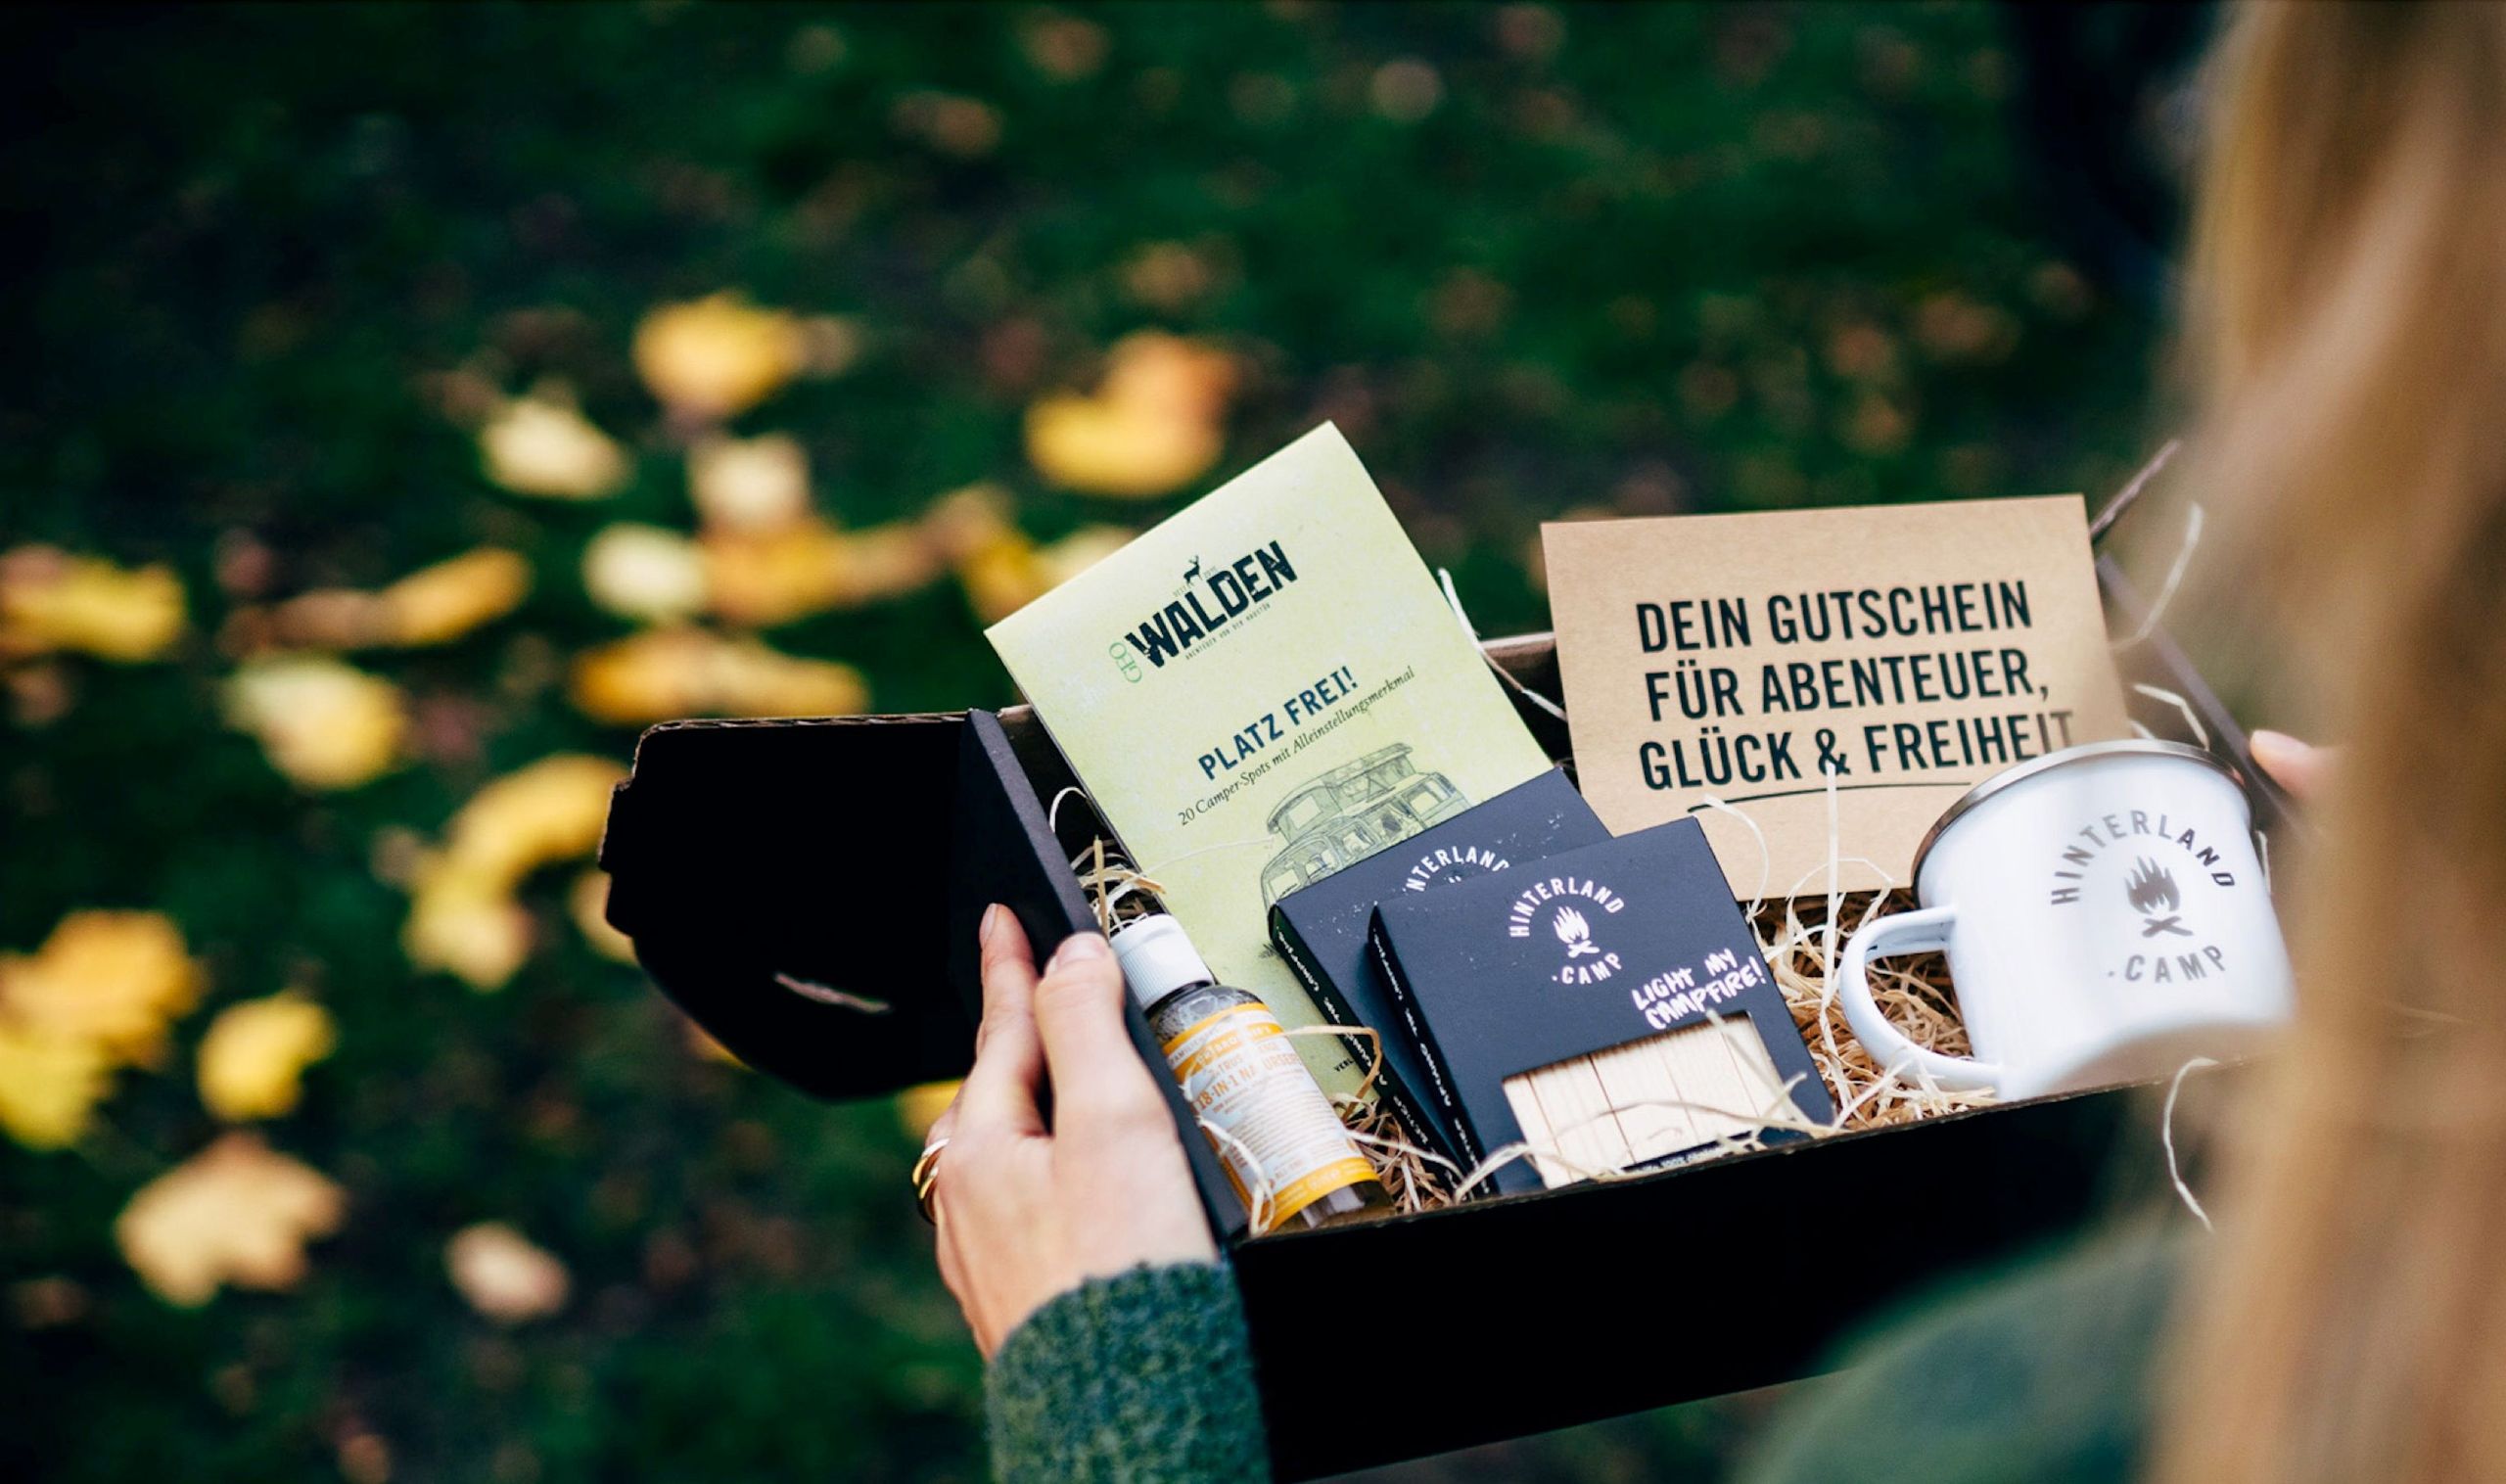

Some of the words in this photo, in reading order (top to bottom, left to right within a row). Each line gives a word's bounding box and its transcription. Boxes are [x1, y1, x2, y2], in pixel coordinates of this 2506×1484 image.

[1124, 540, 1298, 669] WALDEN
[1636, 597, 1751, 654] DEIN
[1767, 580, 2032, 645] GUTSCHEIN
[1197, 713, 1284, 780] PLATZ
[1283, 665, 1359, 725] FREI!
[1645, 659, 1744, 722] FÜR
[1762, 648, 2049, 715] ABENTEUER,
[1178, 808, 1195, 825] 20
[1195, 761, 1272, 814] Camper-Spots
[1273, 747, 1291, 767] mit
[1293, 665, 1415, 755] Alleinstellungsmerkmal
[1640, 726, 1802, 791] GLÜCK
[1815, 728, 1852, 776] &
[1863, 710, 2073, 773] FREIHEIT
[1405, 846, 1509, 892] NTERLAND
[2051, 810, 2236, 905] HINTERLAND
[1508, 877, 1625, 938] HINTERLAND
[1632, 967, 1695, 1011] LIGHT
[1703, 948, 1739, 977] MY
[1645, 955, 1767, 1030] CAMPFIRE!
